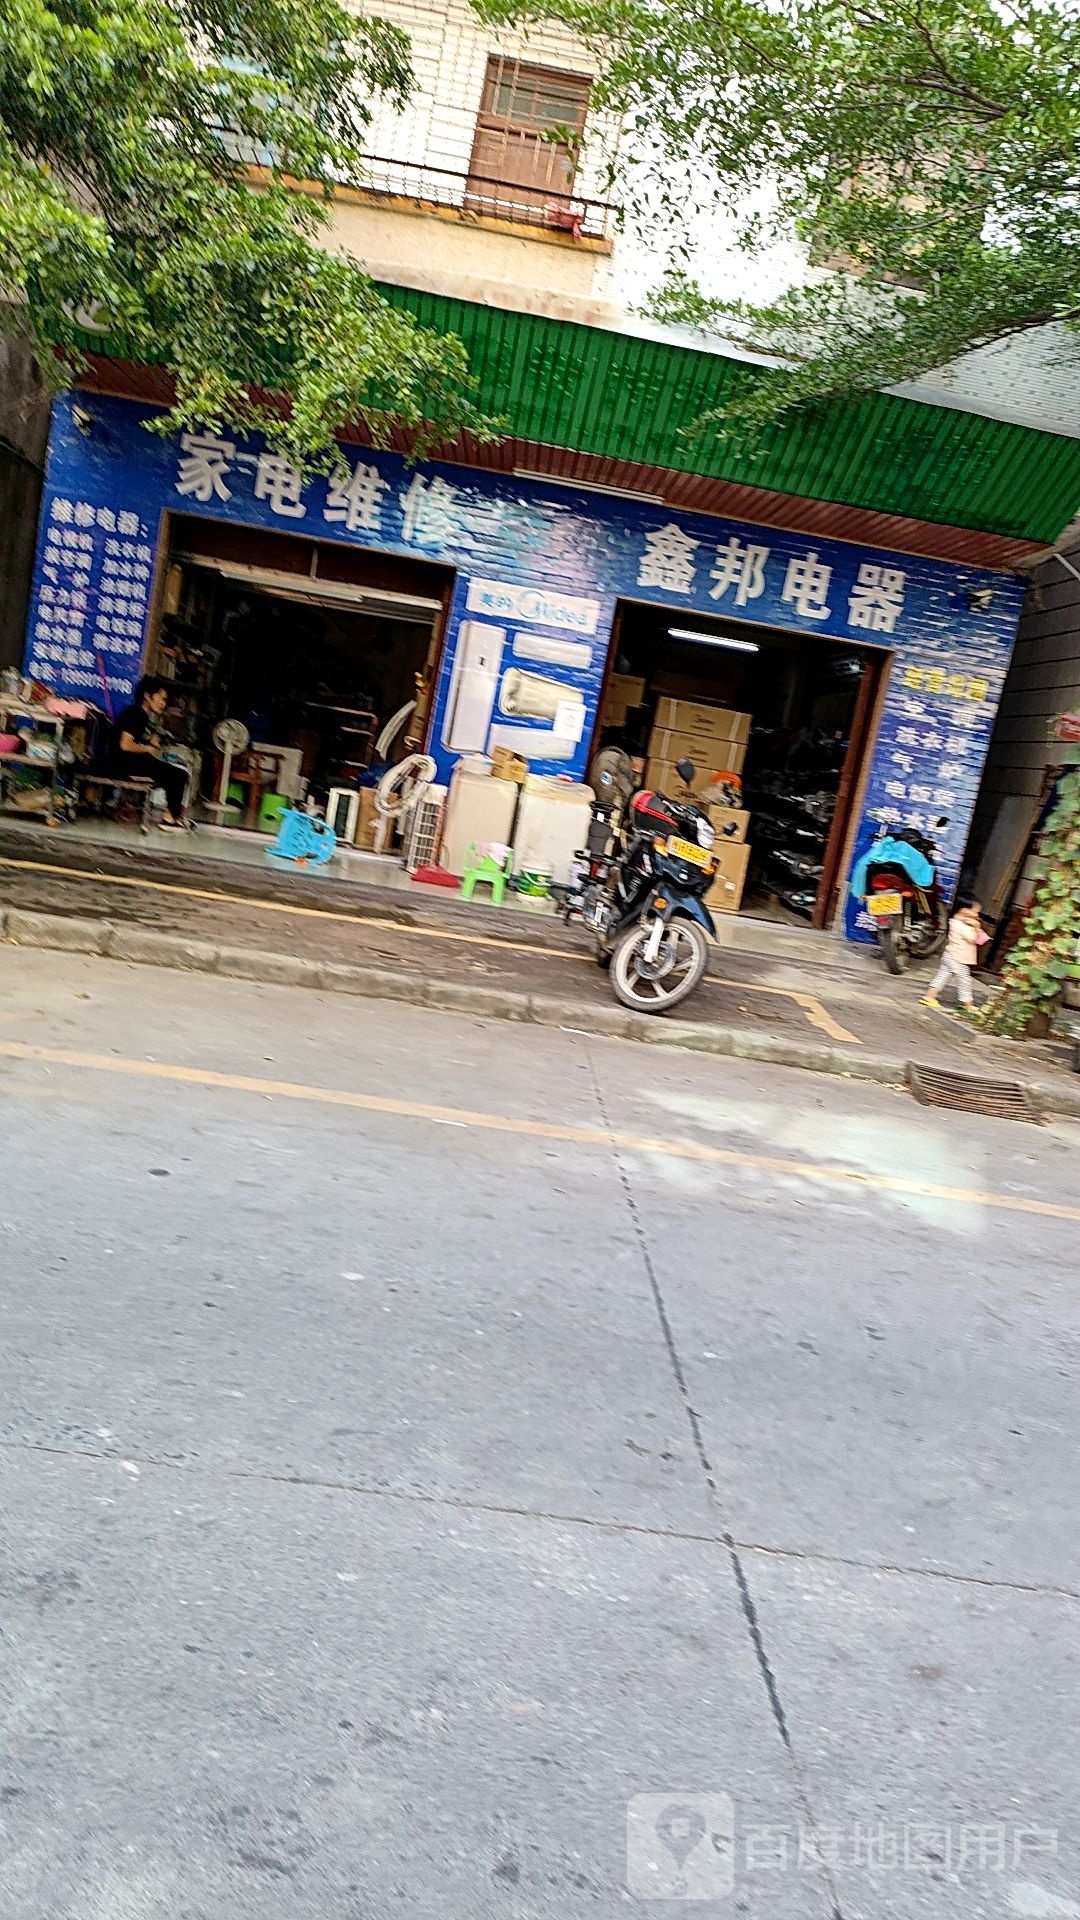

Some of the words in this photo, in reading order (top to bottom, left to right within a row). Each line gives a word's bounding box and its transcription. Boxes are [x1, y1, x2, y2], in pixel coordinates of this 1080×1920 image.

[174, 430, 459, 541] 家电维修
[478, 592, 513, 610] 美的
[636, 522, 906, 633] 鑫邦电器
